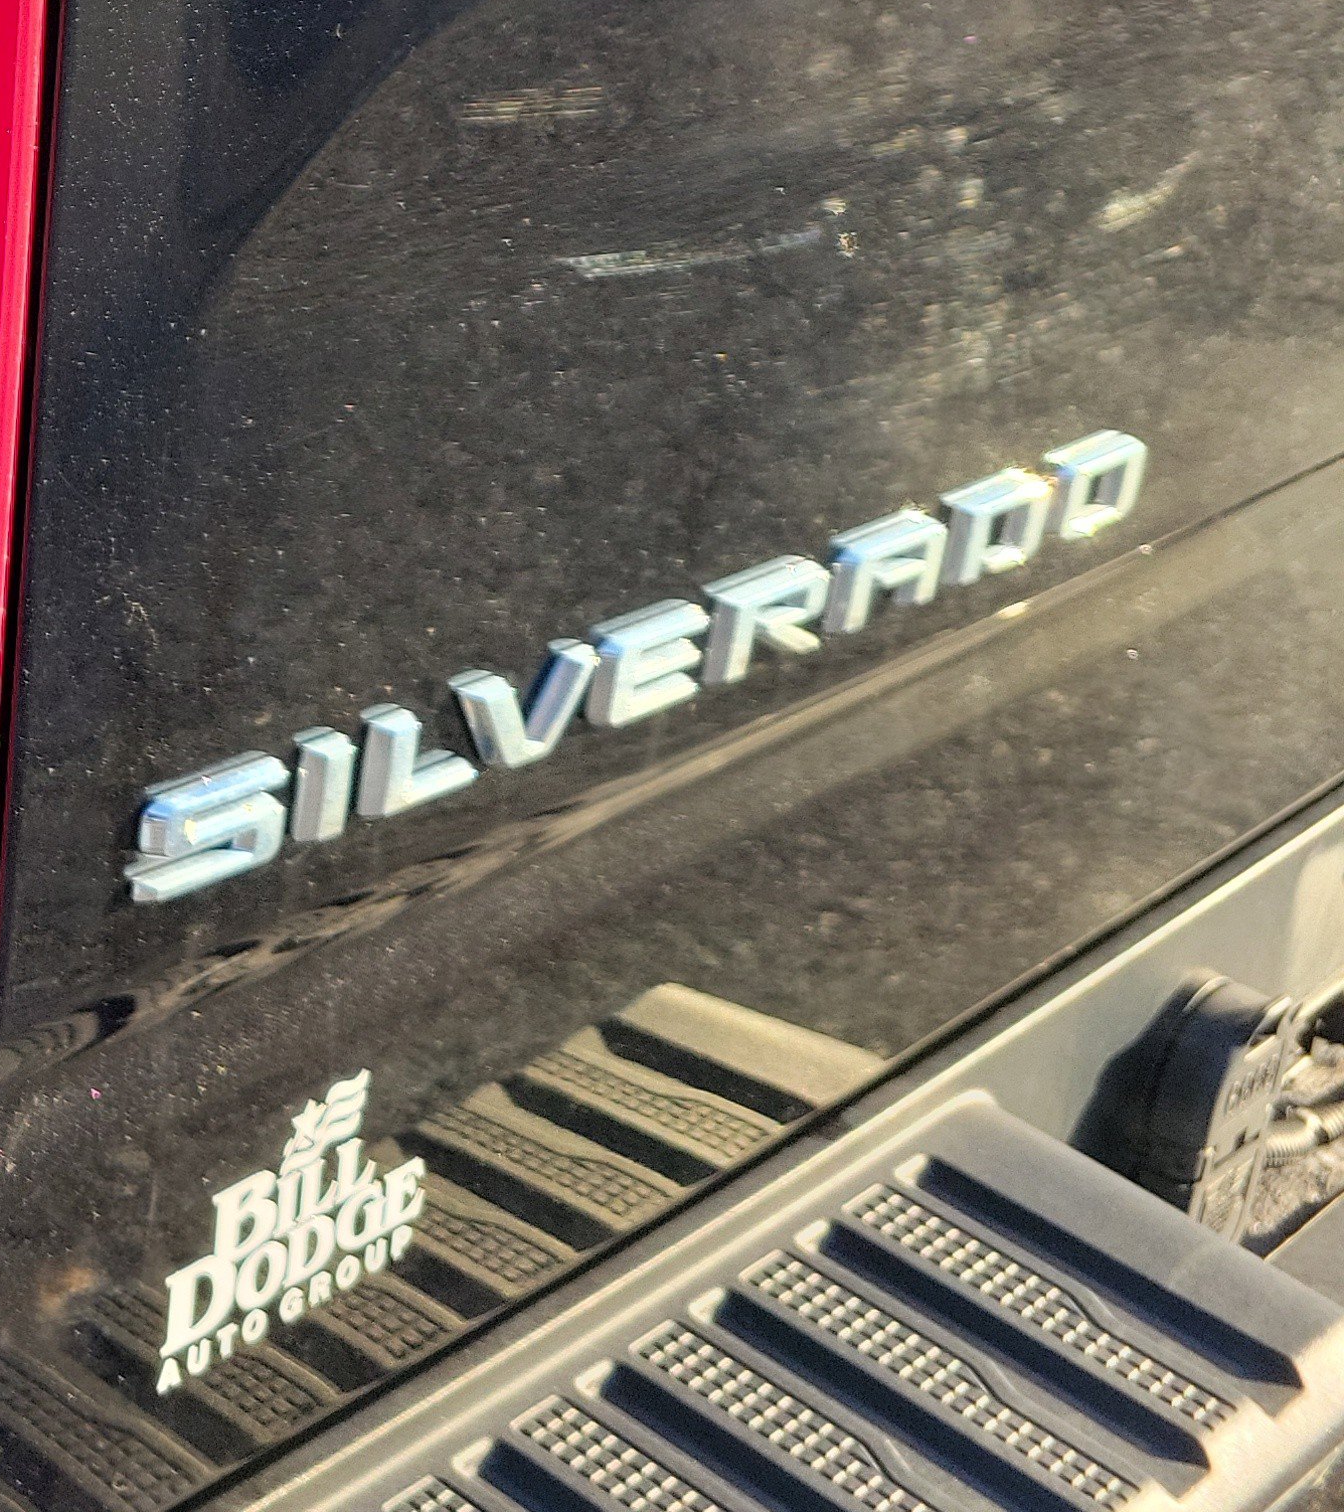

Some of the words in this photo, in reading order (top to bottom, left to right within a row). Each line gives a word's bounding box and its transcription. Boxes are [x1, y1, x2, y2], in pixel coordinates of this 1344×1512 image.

[123, 429, 1147, 904] SILVERADO
[159, 1156, 426, 1358] DODGE
[212, 1137, 378, 1263] BILL
[156, 1308, 269, 1396] AUTO
[278, 1224, 414, 1325] GROUP
